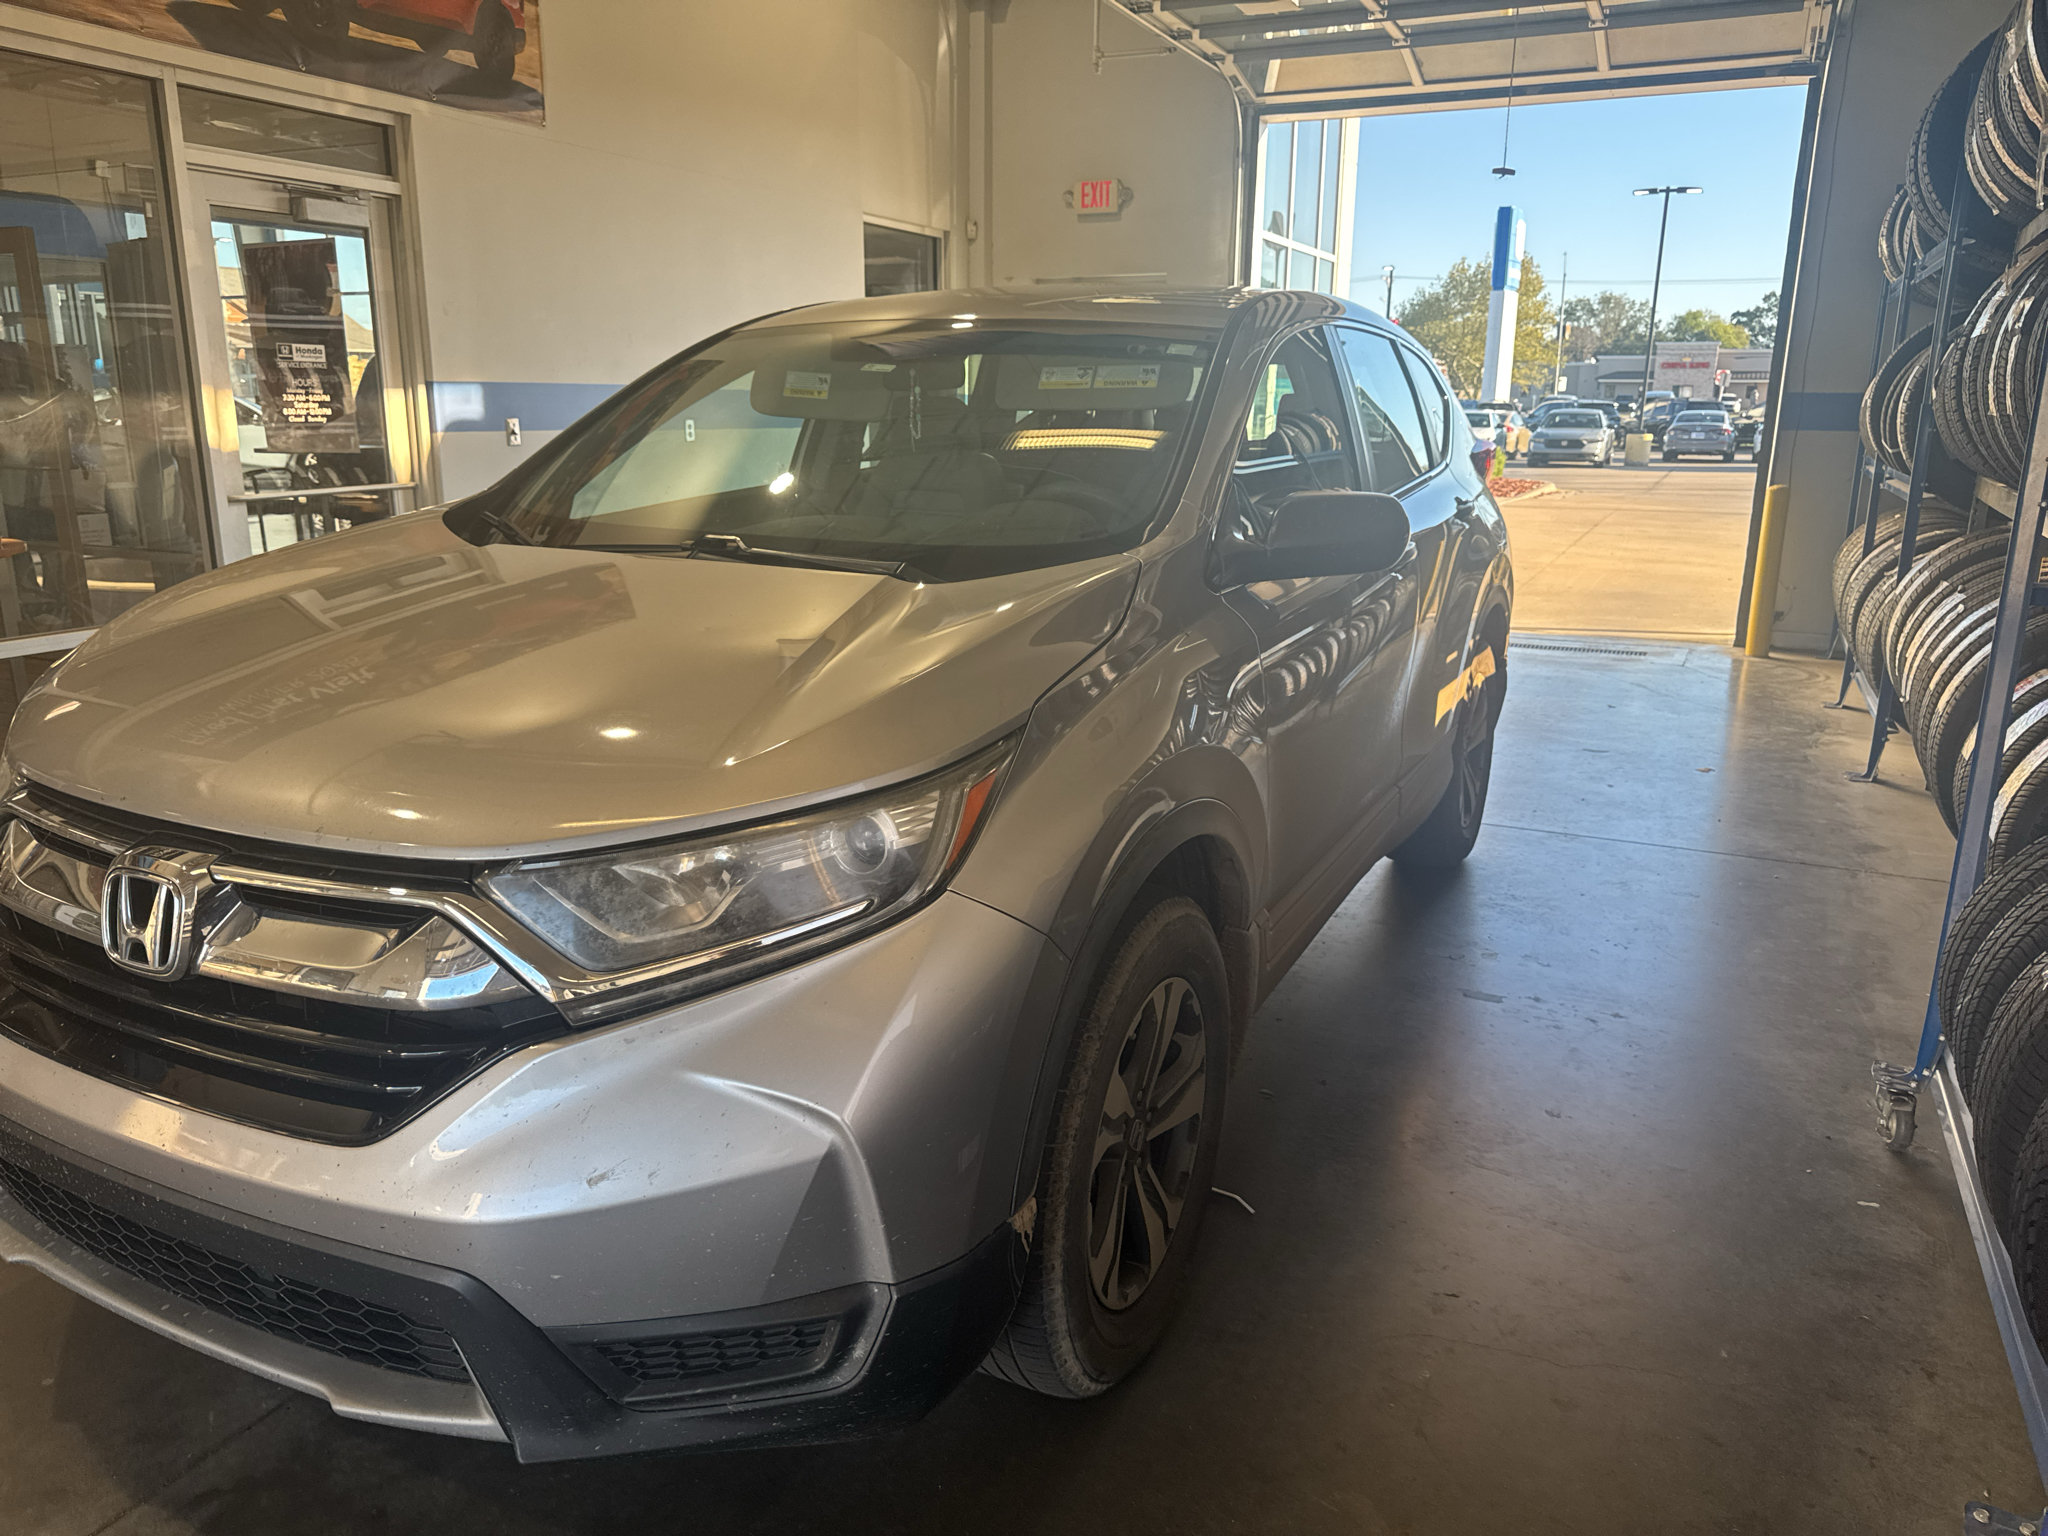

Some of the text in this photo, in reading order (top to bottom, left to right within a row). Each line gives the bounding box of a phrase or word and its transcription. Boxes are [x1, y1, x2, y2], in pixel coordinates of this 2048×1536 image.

[1081, 180, 1112, 208] EXIT
[295, 346, 323, 355] Honda
[288, 415, 328, 424] Closed Sunday
